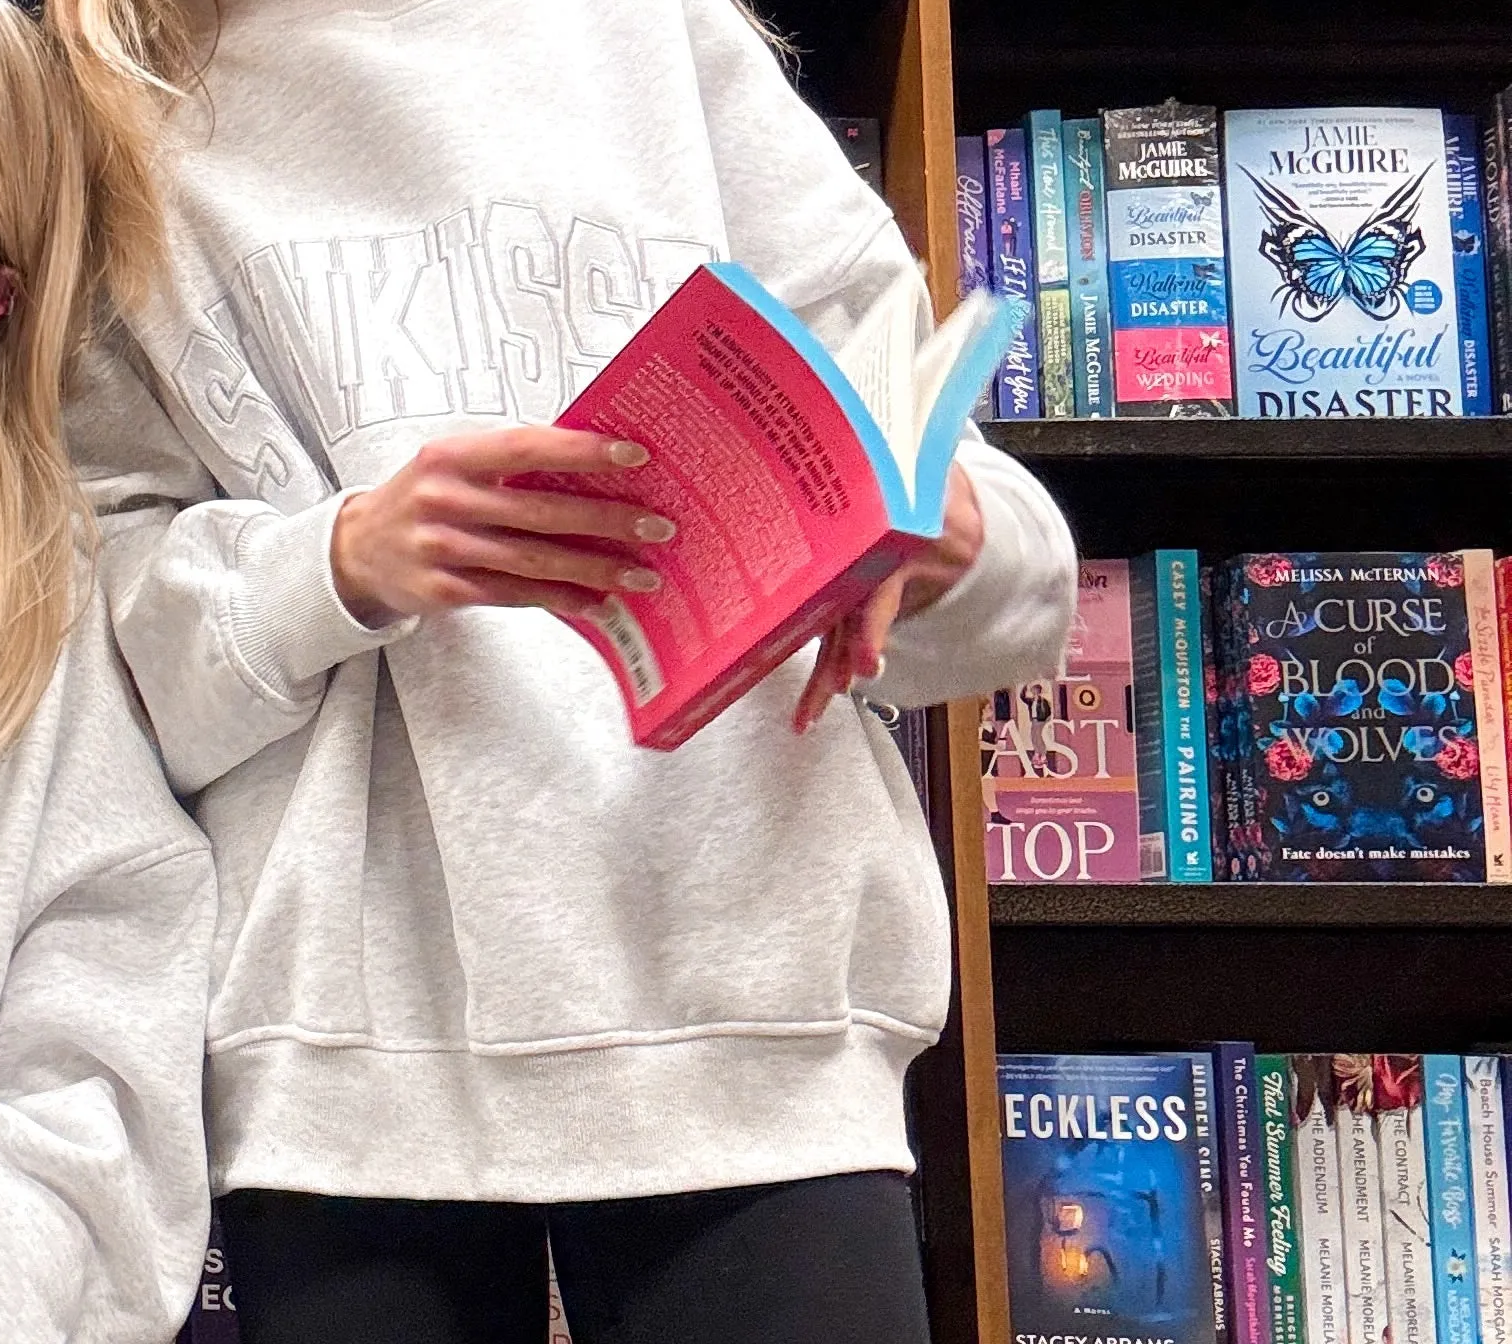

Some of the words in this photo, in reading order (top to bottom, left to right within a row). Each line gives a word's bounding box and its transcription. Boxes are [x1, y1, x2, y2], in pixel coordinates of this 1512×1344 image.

[1301, 125, 1378, 154] JAMIE
[1247, 324, 1449, 387] Beautiful
[1135, 370, 1215, 390] WEDDING
[1258, 389, 1453, 418] DISASTER
[1170, 561, 1183, 612] CASEY
[1275, 568, 1344, 583] MELISSA
[1315, 598, 1448, 637] CURSE
[1354, 636, 1377, 656] of
[1281, 658, 1456, 698] BLOOD
[1179, 717, 1192, 740] THE
[1352, 706, 1386, 721] and
[1290, 726, 1464, 764] WOLVES
[1176, 745, 1199, 844] PAIRING
[1282, 847, 1315, 861] Fate
[1319, 846, 1364, 861] doesn't
[1368, 847, 1406, 860] make
[1409, 846, 1471, 861] mistakes
[1004, 1093, 1187, 1142] ECKLESS
[1312, 1134, 1329, 1215] ADDENDUM
[1319, 1237, 1332, 1291] MELANIE
